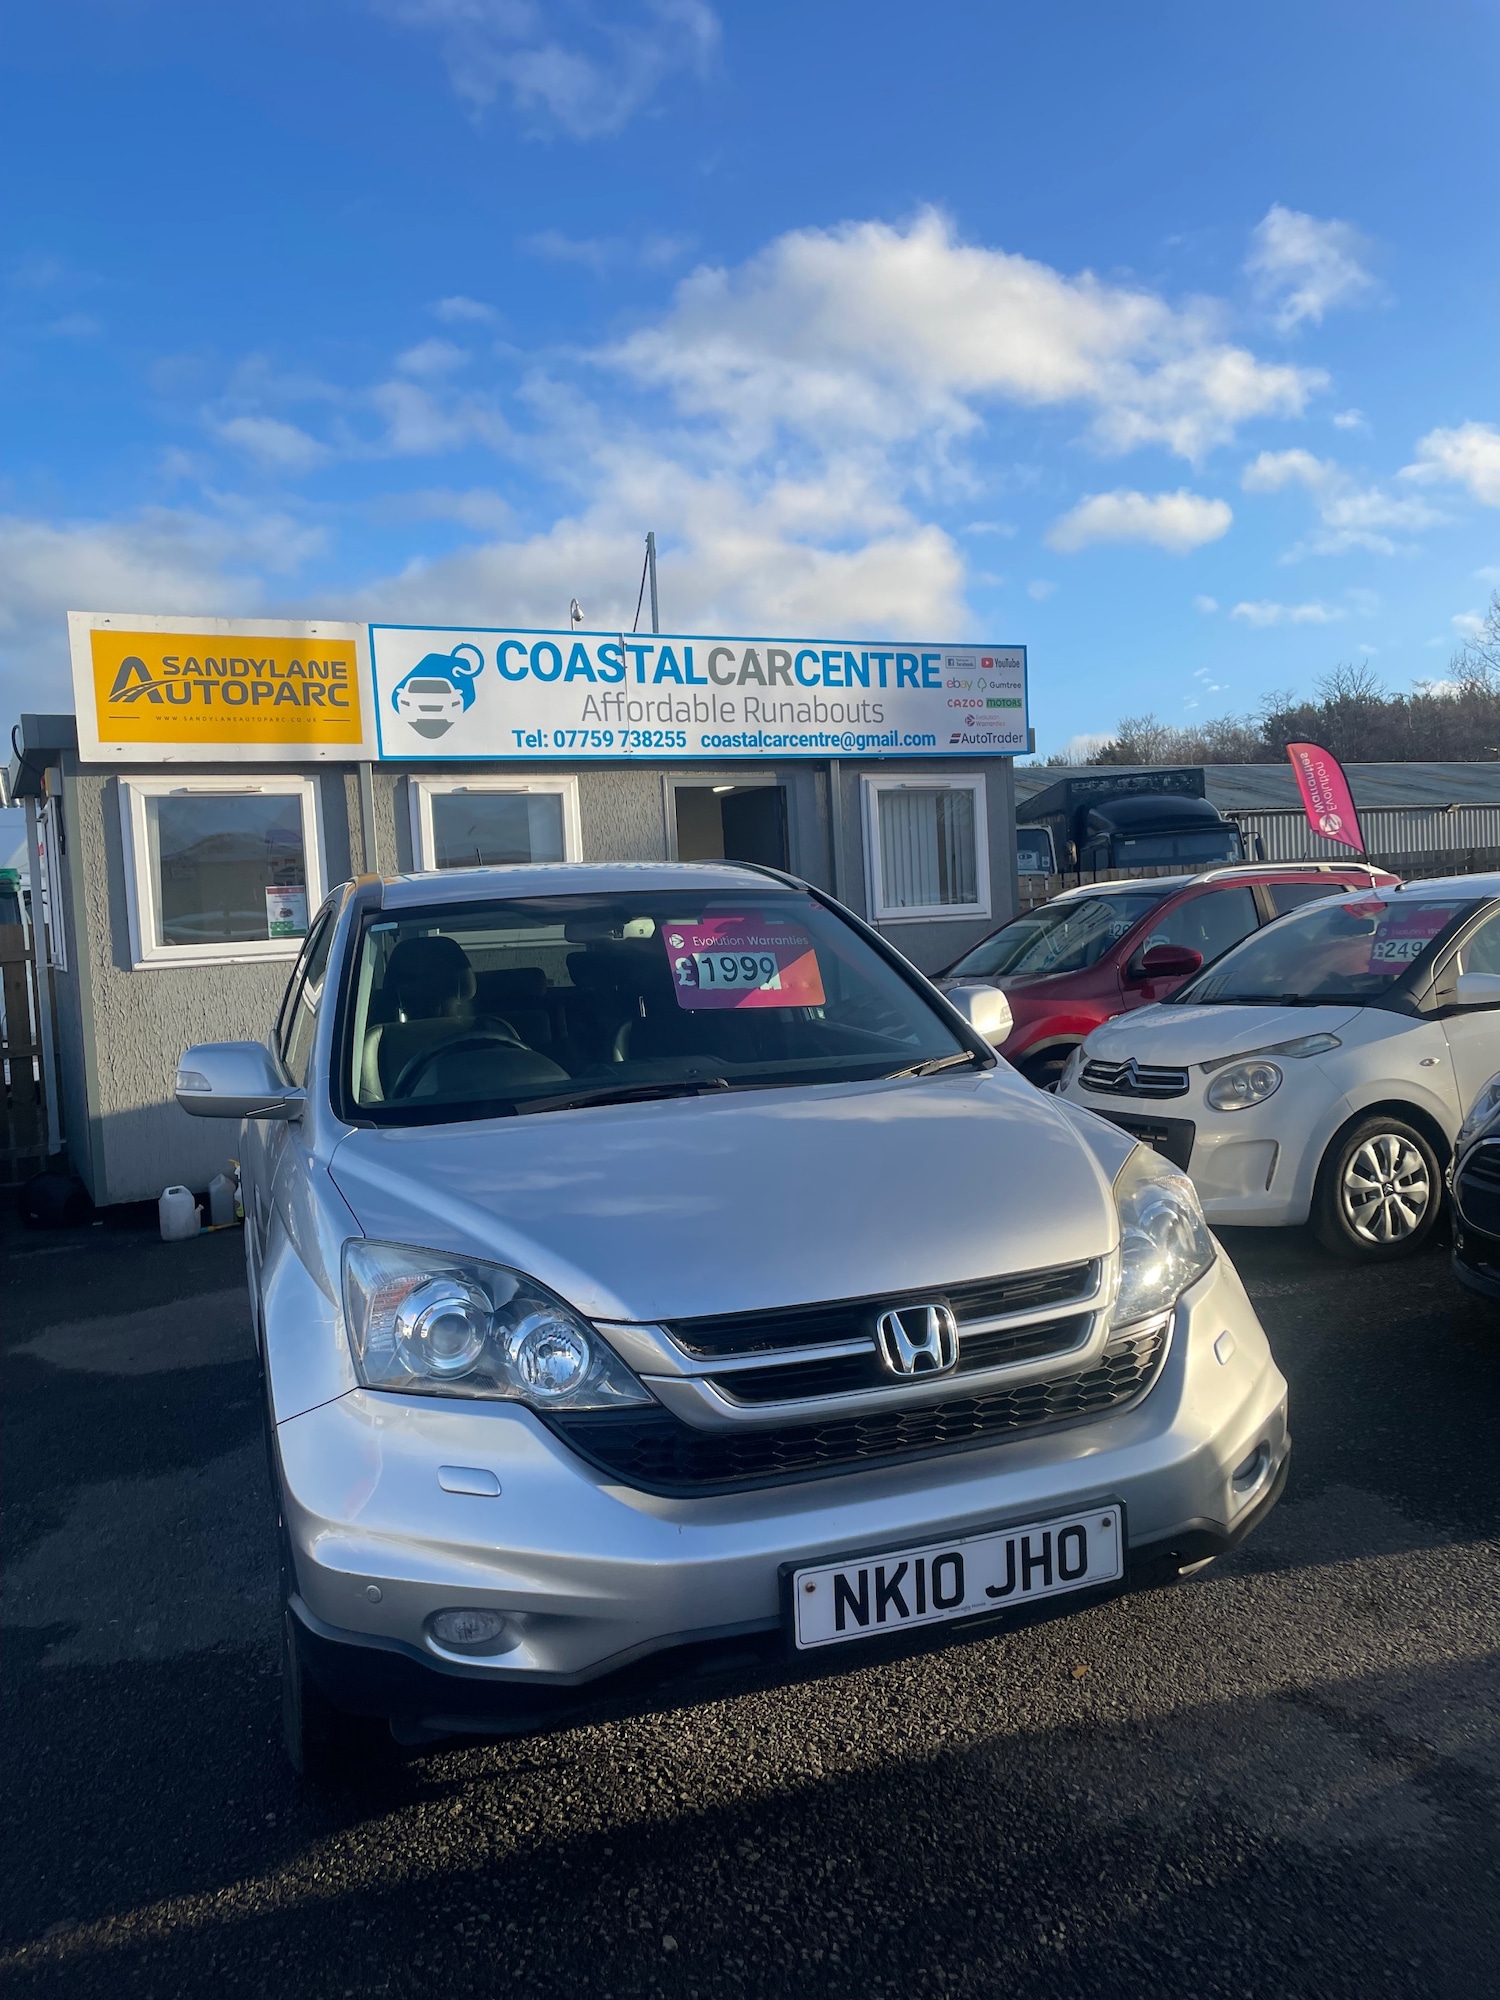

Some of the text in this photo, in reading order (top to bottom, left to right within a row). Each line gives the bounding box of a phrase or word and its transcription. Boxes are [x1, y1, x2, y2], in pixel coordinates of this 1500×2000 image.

[163, 657, 347, 679] SANDYLANE
[496, 640, 942, 688] COASTALCARCENTRE
[995, 658, 1020, 668] YouTube
[108, 656, 349, 706] AUTOPARC
[947, 678, 973, 691] ebay
[989, 681, 1021, 689] Gumtree
[581, 691, 884, 724] Affordable Runabouts
[947, 699, 984, 707] CAZOO
[512, 729, 687, 748] Tel: 07759 738255
[701, 730, 936, 750] coastalcarcentre@gmail.com
[961, 732, 1023, 744] AutoTrader
[692, 935, 809, 947] Evolution Warranties
